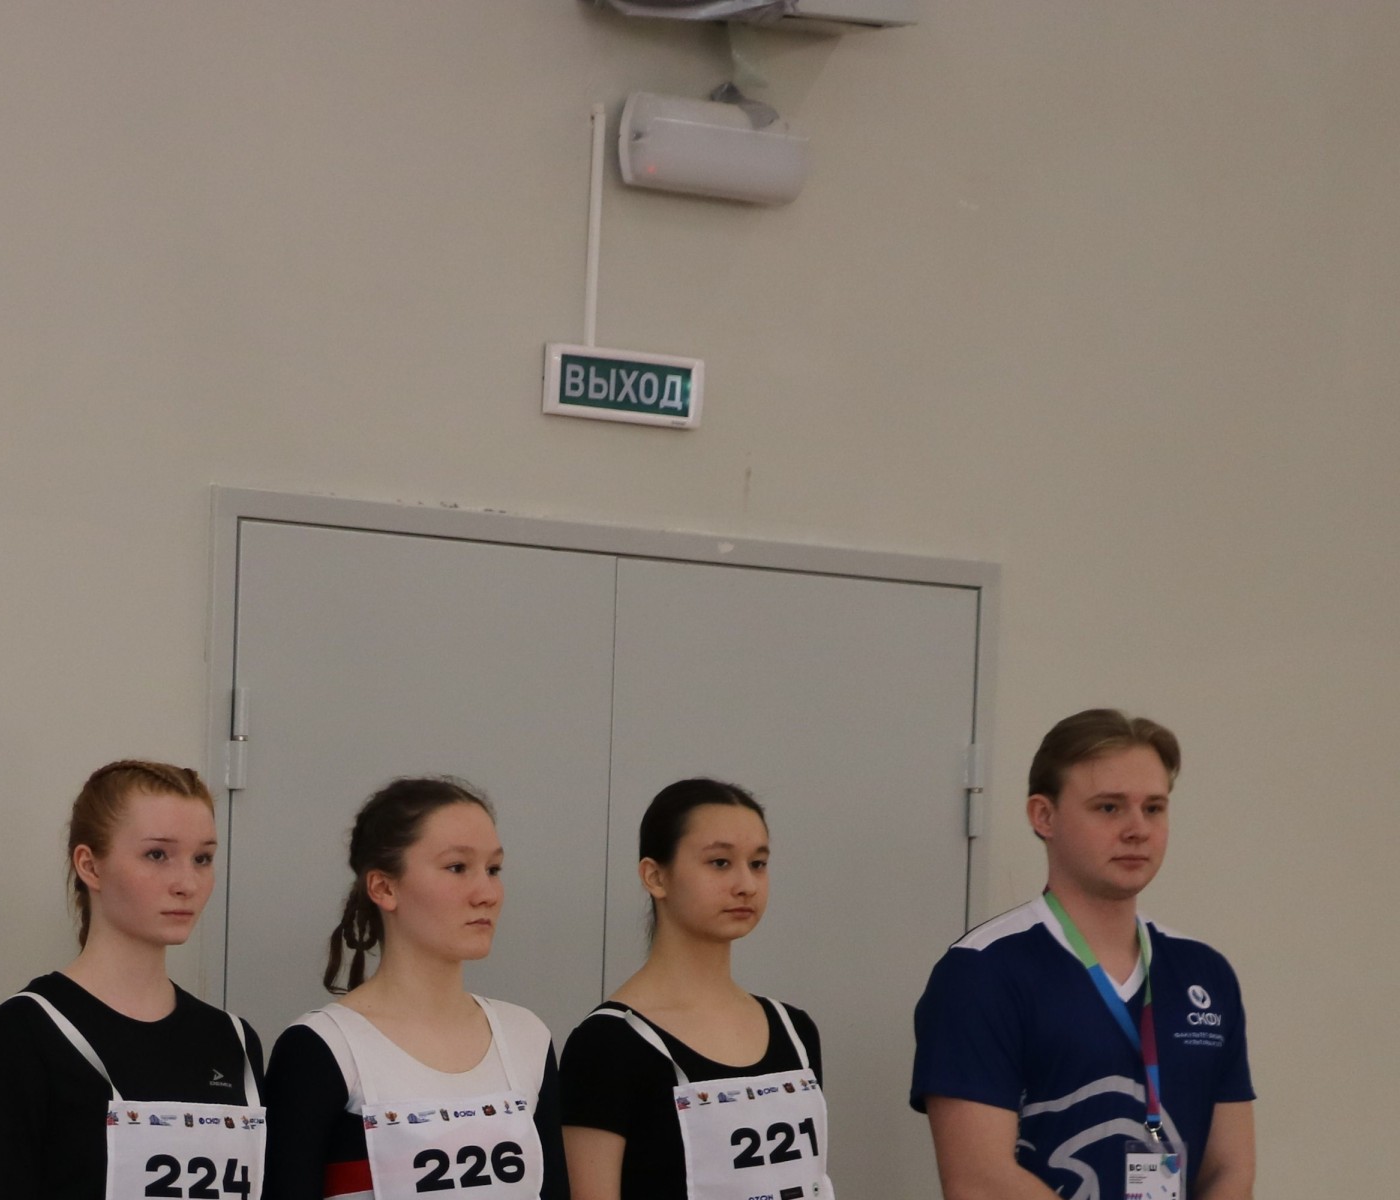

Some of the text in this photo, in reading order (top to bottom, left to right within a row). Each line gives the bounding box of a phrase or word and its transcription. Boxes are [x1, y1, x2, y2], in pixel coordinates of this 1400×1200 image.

[565, 364, 683, 410] ВЫХОД
[1187, 1012, 1222, 1026] СКФУ
[730, 1117, 819, 1169] 221
[145, 1154, 251, 1200] 224
[413, 1141, 525, 1193] 226
